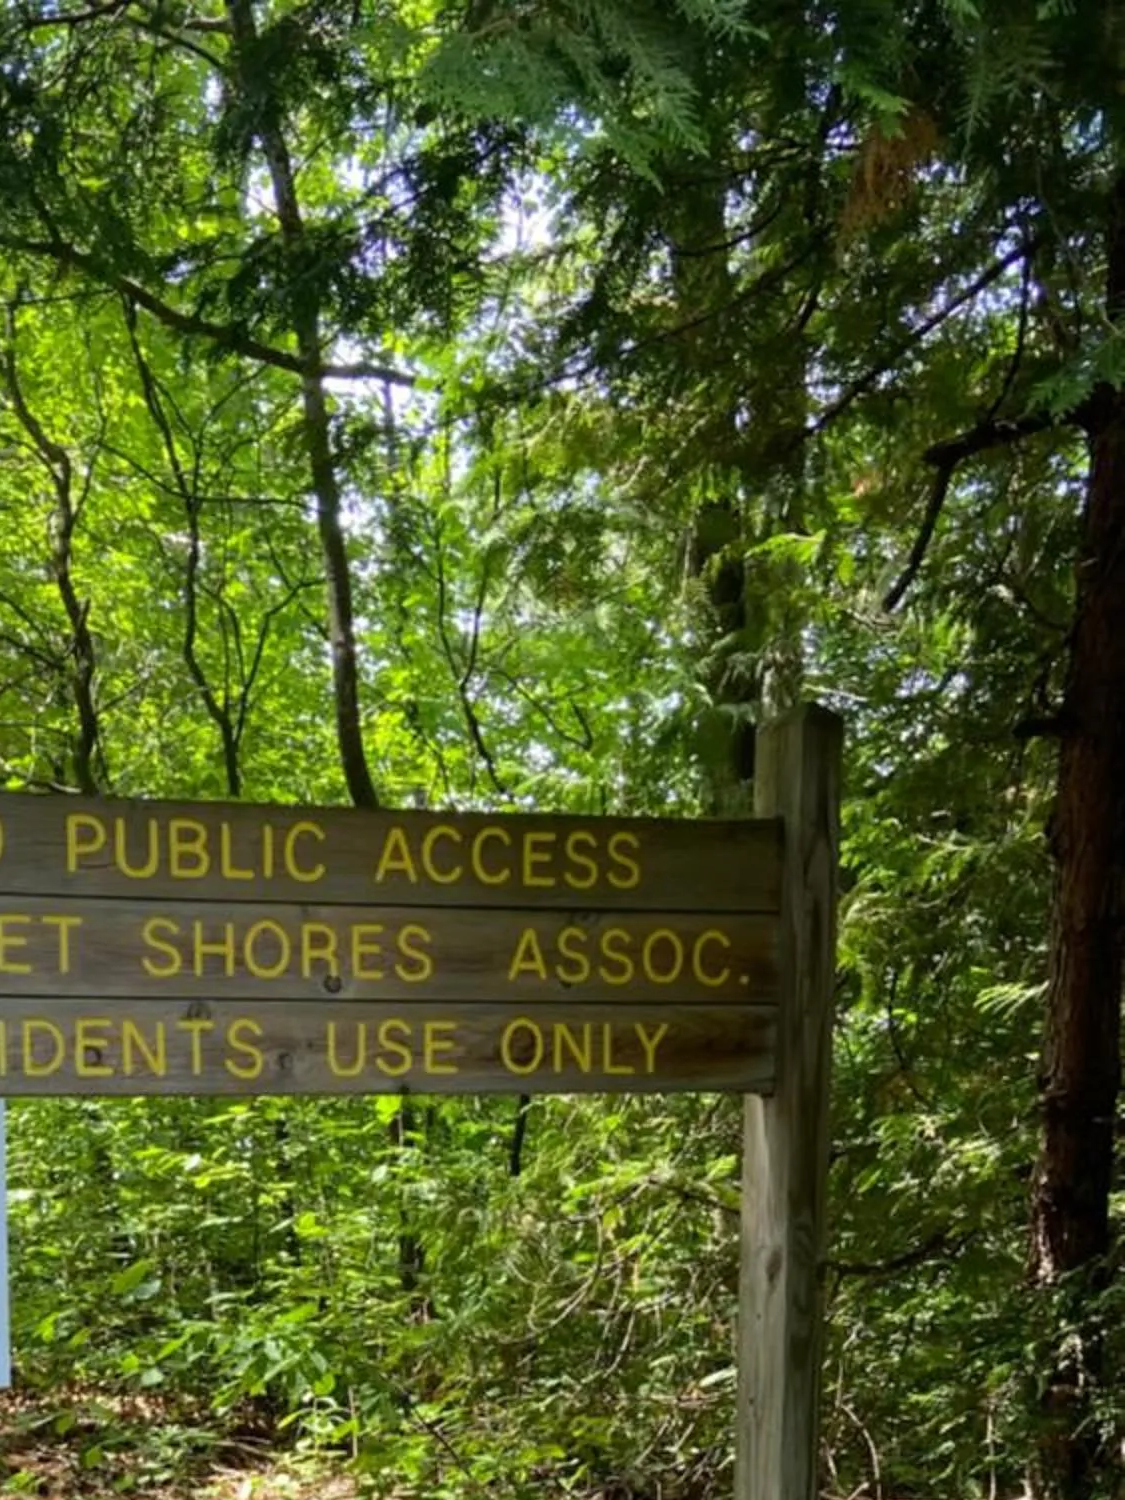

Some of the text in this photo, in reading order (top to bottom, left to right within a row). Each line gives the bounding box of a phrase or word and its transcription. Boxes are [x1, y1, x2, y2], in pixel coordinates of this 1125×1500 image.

[66, 814, 326, 882] PUBLIC
[376, 825, 641, 889] ACCESS
[140, 917, 434, 982] SHORES
[508, 927, 750, 986] ASSOC.
[326, 1019, 459, 1077] USE
[501, 1017, 669, 1075] ONLY
